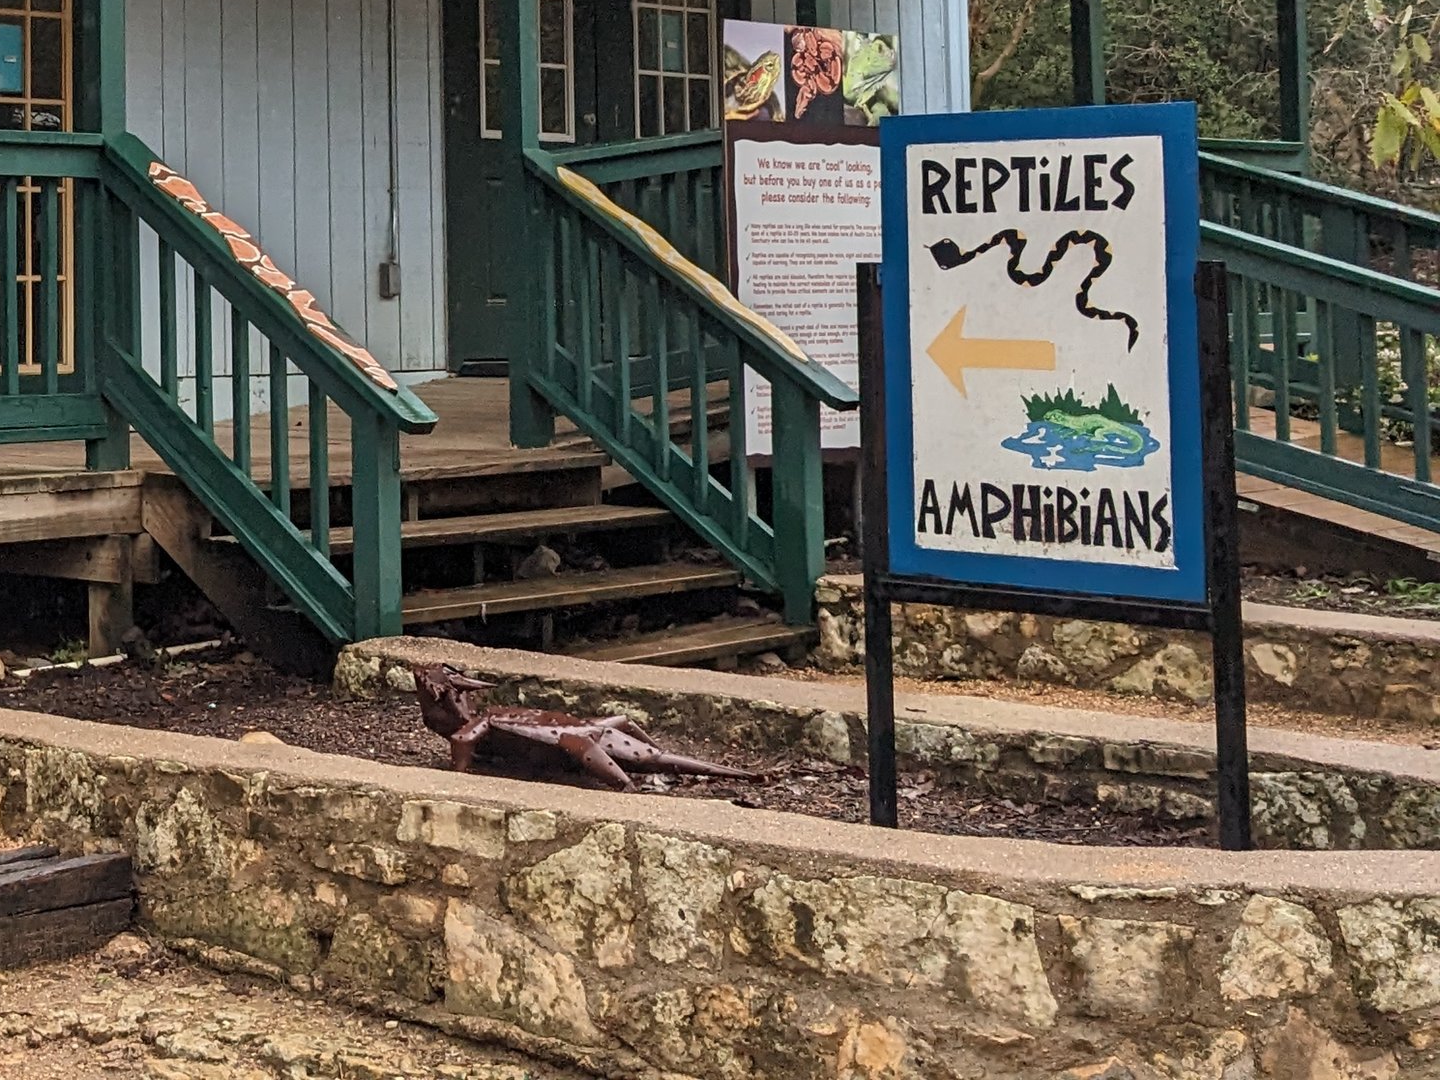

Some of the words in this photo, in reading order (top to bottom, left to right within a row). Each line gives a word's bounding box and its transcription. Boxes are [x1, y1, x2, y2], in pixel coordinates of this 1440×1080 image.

[757, 158, 770, 169] We
[773, 158, 792, 170] know
[795, 161, 806, 170] we
[808, 162, 820, 171] are
[743, 174, 756, 185] but
[759, 174, 784, 186] before
[786, 177, 800, 189] you
[803, 176, 816, 189] buy
[819, 178, 832, 187] one
[834, 176, 842, 187] of
[845, 178, 853, 188] us
[856, 179, 864, 188] as
[867, 180, 871, 188] a
[761, 192, 785, 205] please
[788, 192, 819, 203] consider
[822, 192, 834, 204] the
